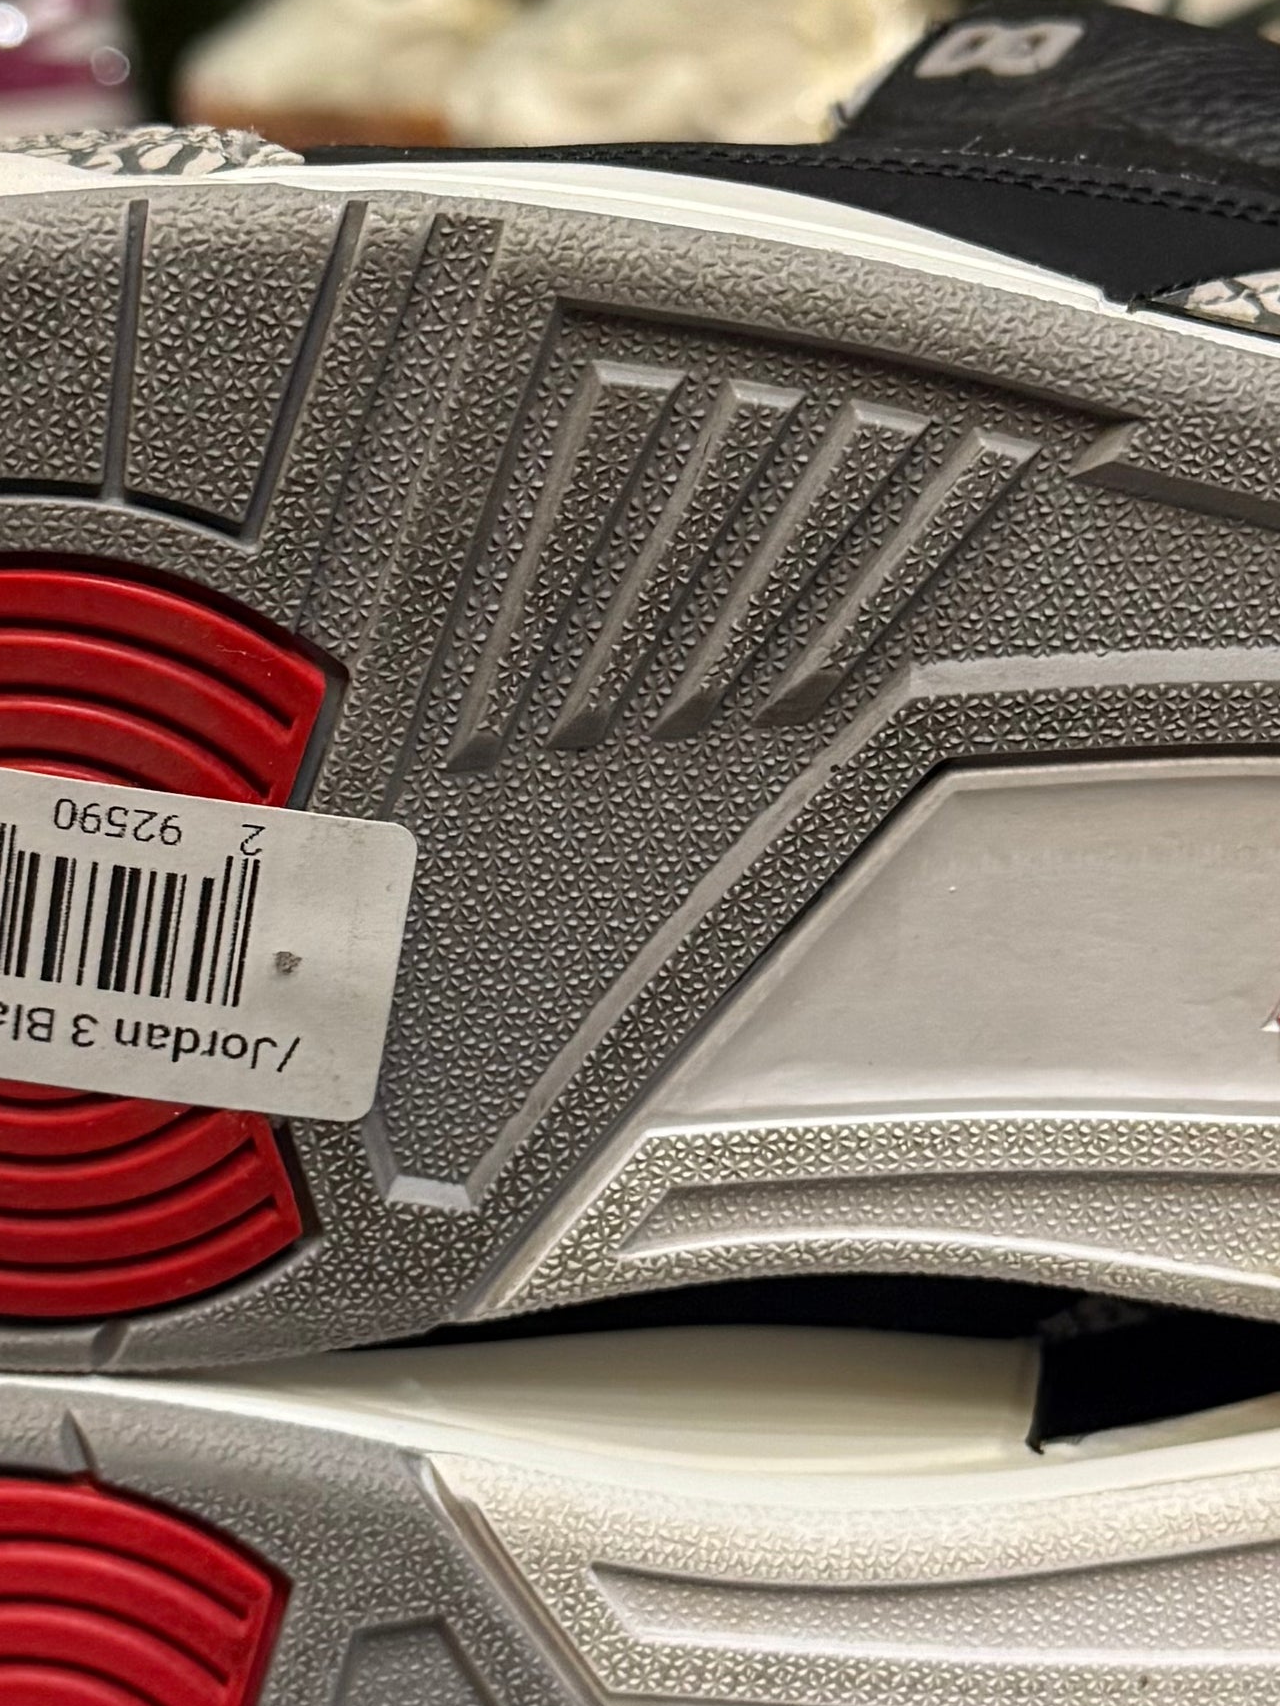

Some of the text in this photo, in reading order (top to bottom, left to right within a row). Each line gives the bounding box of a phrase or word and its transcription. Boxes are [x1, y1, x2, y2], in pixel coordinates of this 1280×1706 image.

[52, 797, 183, 847] 92590
[239, 823, 267, 857] 2
[71, 1013, 100, 1048] 3
[115, 1016, 302, 1074] /Jordan
